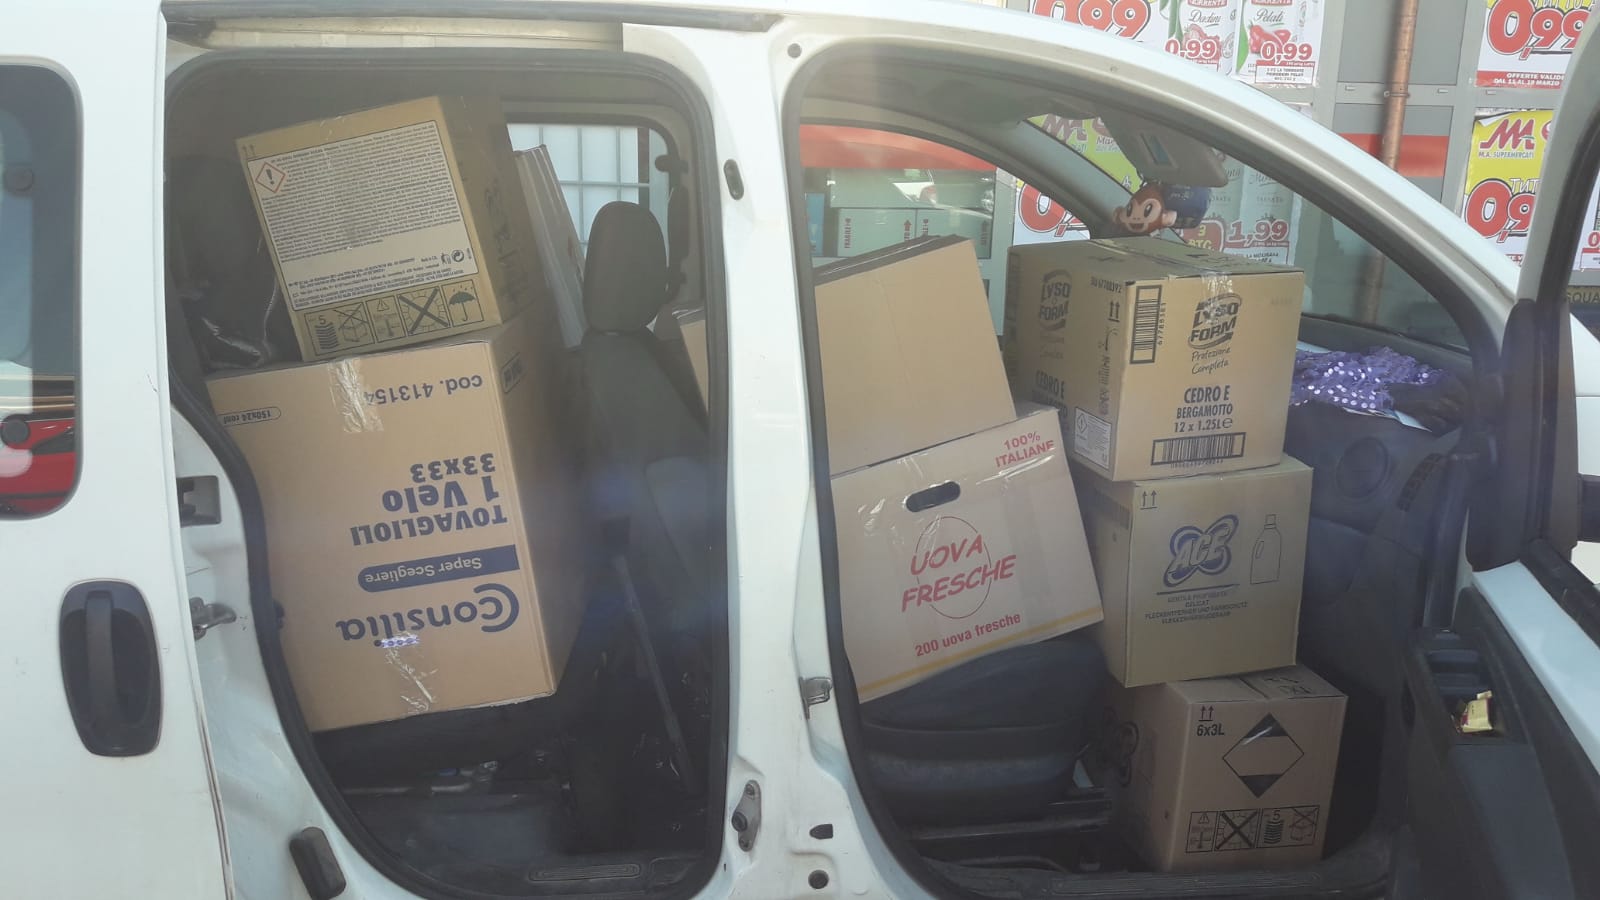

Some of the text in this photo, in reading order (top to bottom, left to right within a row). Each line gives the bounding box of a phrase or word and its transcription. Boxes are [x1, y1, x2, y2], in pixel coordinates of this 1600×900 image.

[1261, 41, 1313, 64] 0,99
[1509, 177, 1541, 194] TUT
[1466, 178, 1536, 244] 0,9
[1226, 219, 1290, 247] 1,99
[1038, 301, 1069, 321] FORM
[1190, 315, 1238, 342] FORM
[1191, 359, 1230, 375] Completa
[364, 374, 483, 406] cod. 413154
[1184, 384, 1231, 404] CEDRO E
[1176, 403, 1233, 419] BERGAMOTTO
[1174, 421, 1186, 433] 12
[1188, 423, 1194, 431] x
[995, 440, 1055, 468] ITALIANE
[1004, 431, 1041, 451] 100%
[410, 453, 496, 484] 33x33
[382, 475, 499, 514] 1 Velo
[350, 504, 508, 546] TOVAGLIOLI
[910, 533, 984, 576] UOVA
[365, 557, 483, 584] Saper Scegliere
[901, 554, 1018, 613] FRESCHE
[336, 583, 520, 647] Consilia
[914, 613, 1021, 657] 200 uova fresche
[1196, 723, 1225, 737] 6x3L
